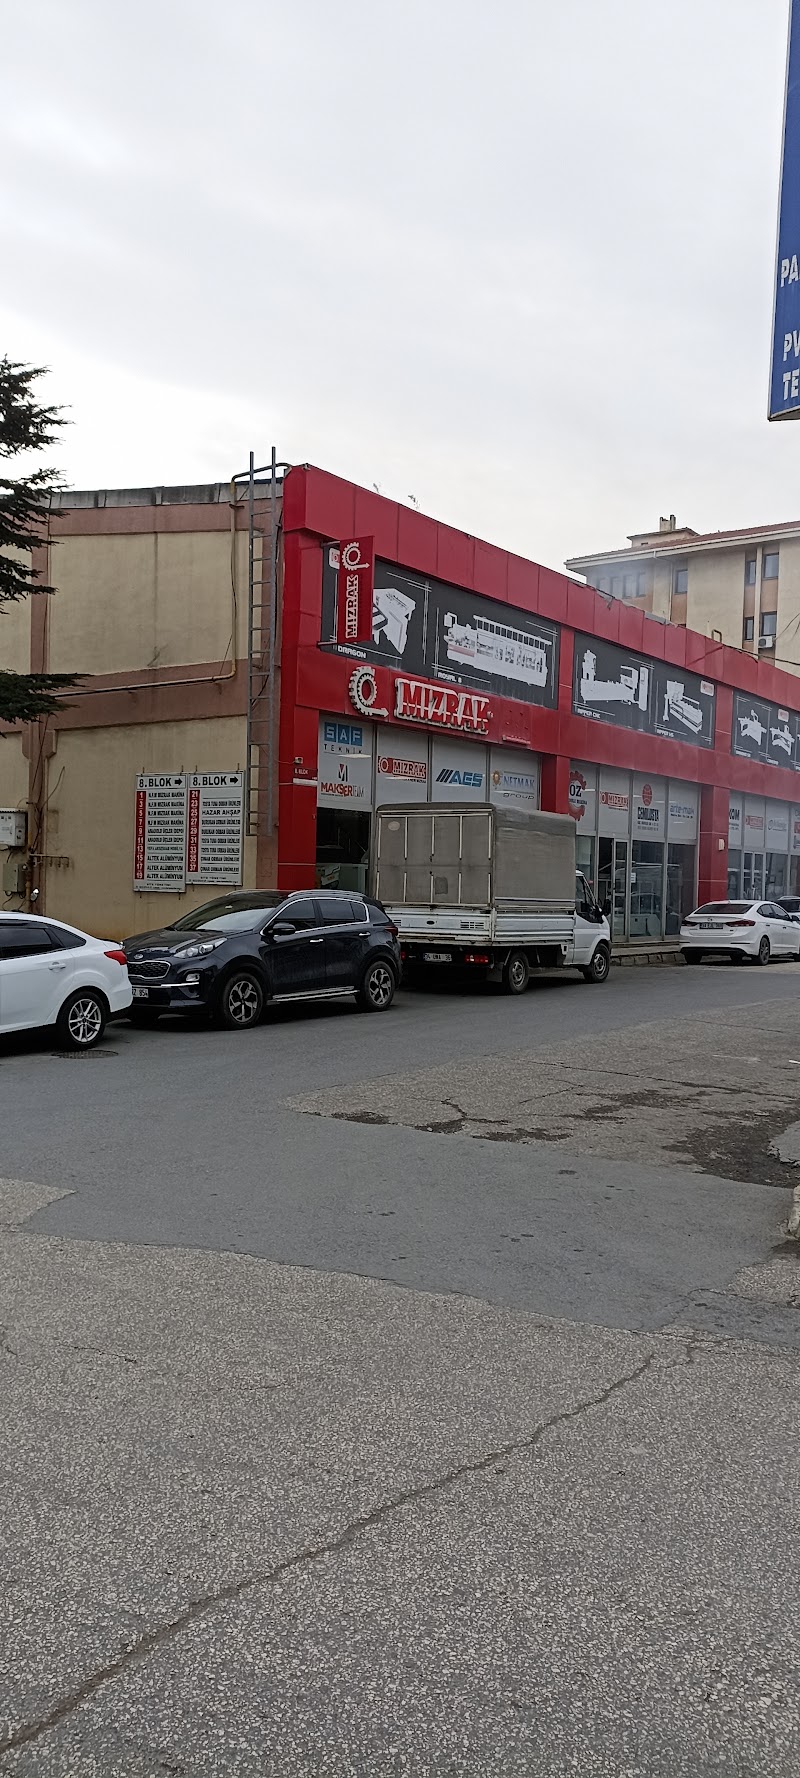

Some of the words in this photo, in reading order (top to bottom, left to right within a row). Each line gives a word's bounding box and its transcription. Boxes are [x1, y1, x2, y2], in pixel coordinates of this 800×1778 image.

[345, 574, 359, 639] MIZRAK
[397, 679, 490, 735] MIZRAK
[326, 725, 361, 742] SAF
[393, 759, 426, 778] MIZRAK
[503, 775, 535, 790] NETMAK
[502, 792, 535, 800] group
